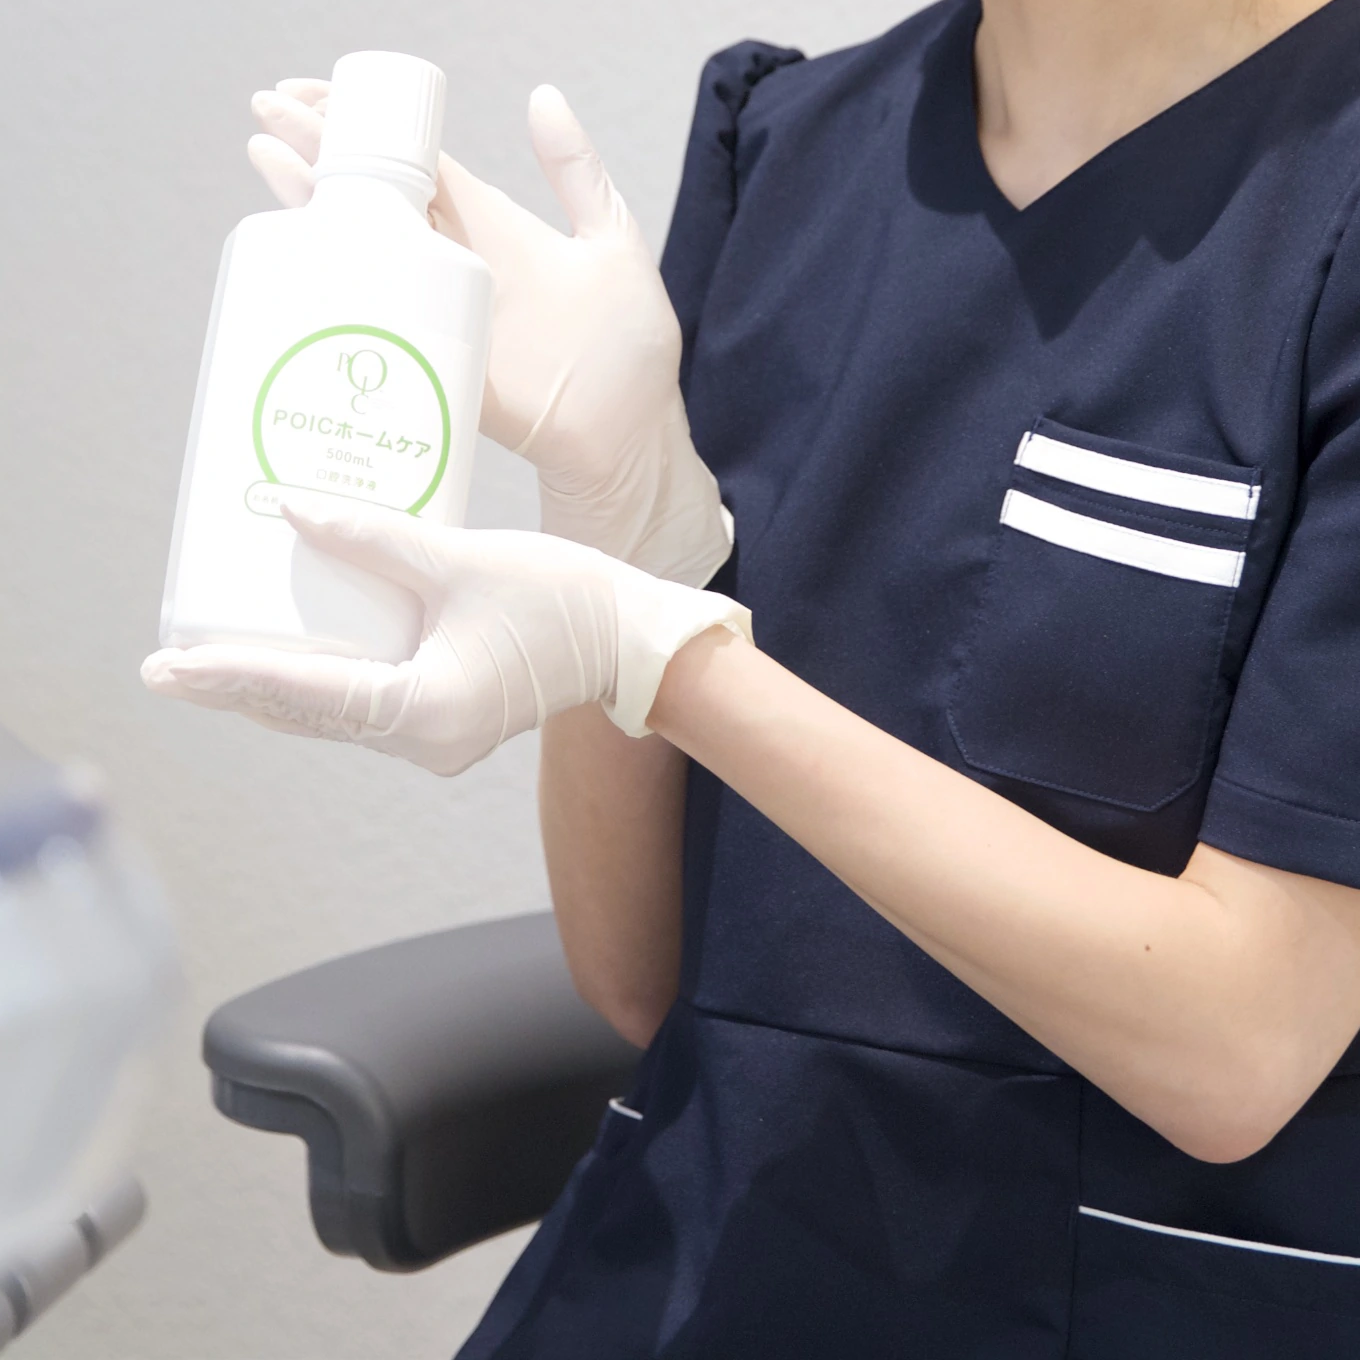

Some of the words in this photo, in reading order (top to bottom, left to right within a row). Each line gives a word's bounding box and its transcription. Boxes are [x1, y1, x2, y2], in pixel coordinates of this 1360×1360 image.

[273, 409, 431, 459] POICホームケア
[326, 447, 374, 469] 500mL
